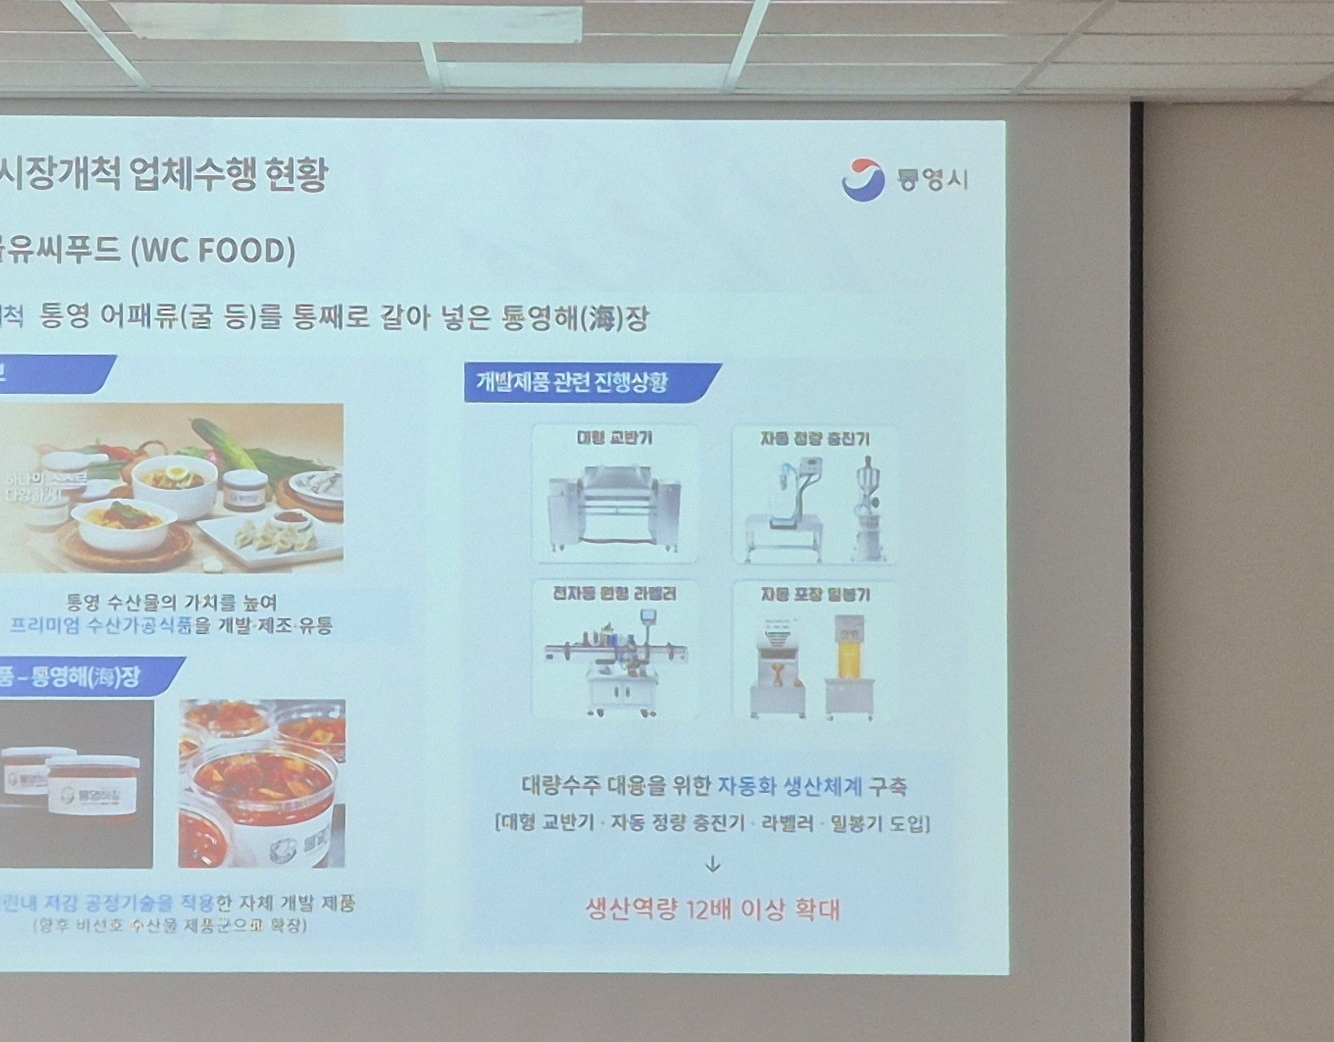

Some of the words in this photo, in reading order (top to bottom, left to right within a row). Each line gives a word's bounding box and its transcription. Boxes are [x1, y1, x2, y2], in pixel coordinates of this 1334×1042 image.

[129, 155, 257, 193] 업체수행
[264, 155, 330, 194] 현황
[897, 167, 969, 193] 통영시
[130, 235, 190, 268] (WC
[198, 236, 296, 269] FOOD)
[40, 301, 90, 330] 통영
[100, 302, 214, 331] 어패류(굴
[223, 303, 283, 331] 등)를
[292, 303, 370, 331] 통째로
[380, 303, 432, 332] 갈아
[441, 303, 492, 332] 넣은
[501, 304, 651, 333] 통영해(海)장
[476, 370, 552, 394] 개발제품
[552, 370, 591, 394] 관련
[594, 371, 669, 395] 진행상황
[67, 592, 101, 613] 통영
[107, 592, 178, 613] 수산물의
[184, 593, 236, 613] 가치를
[243, 593, 278, 614] 높여
[9, 615, 81, 636] 프리미엄
[87, 615, 212, 636] 수산가공식품을
[30, 664, 142, 690] 통영해(海)장
[520, 773, 602, 797] 대량수주
[606, 774, 667, 798] 대응을
[672, 774, 713, 798] 위한
[717, 775, 778, 798] 자동화
[783, 775, 863, 798] 생산체계
[868, 776, 908, 798] 구축
[494, 812, 537, 833] [대형
[542, 812, 595, 833] 교반기
[610, 812, 646, 833] 자동
[652, 813, 688, 833] 정량
[692, 813, 745, 834] 충진기
[830, 813, 883, 834] 밀봉기
[890, 814, 931, 835] 도입]
[43, 893, 80, 914] 저감
[85, 893, 175, 914] 공정기술을
[181, 893, 233, 914] 적용한
[239, 893, 274, 913] 자체
[280, 893, 315, 914] 개발
[321, 893, 357, 914] 제품
[585, 896, 679, 922] 생산역량
[686, 896, 733, 921] 12배
[740, 897, 787, 923] 이상
[795, 897, 841, 923] 확대
